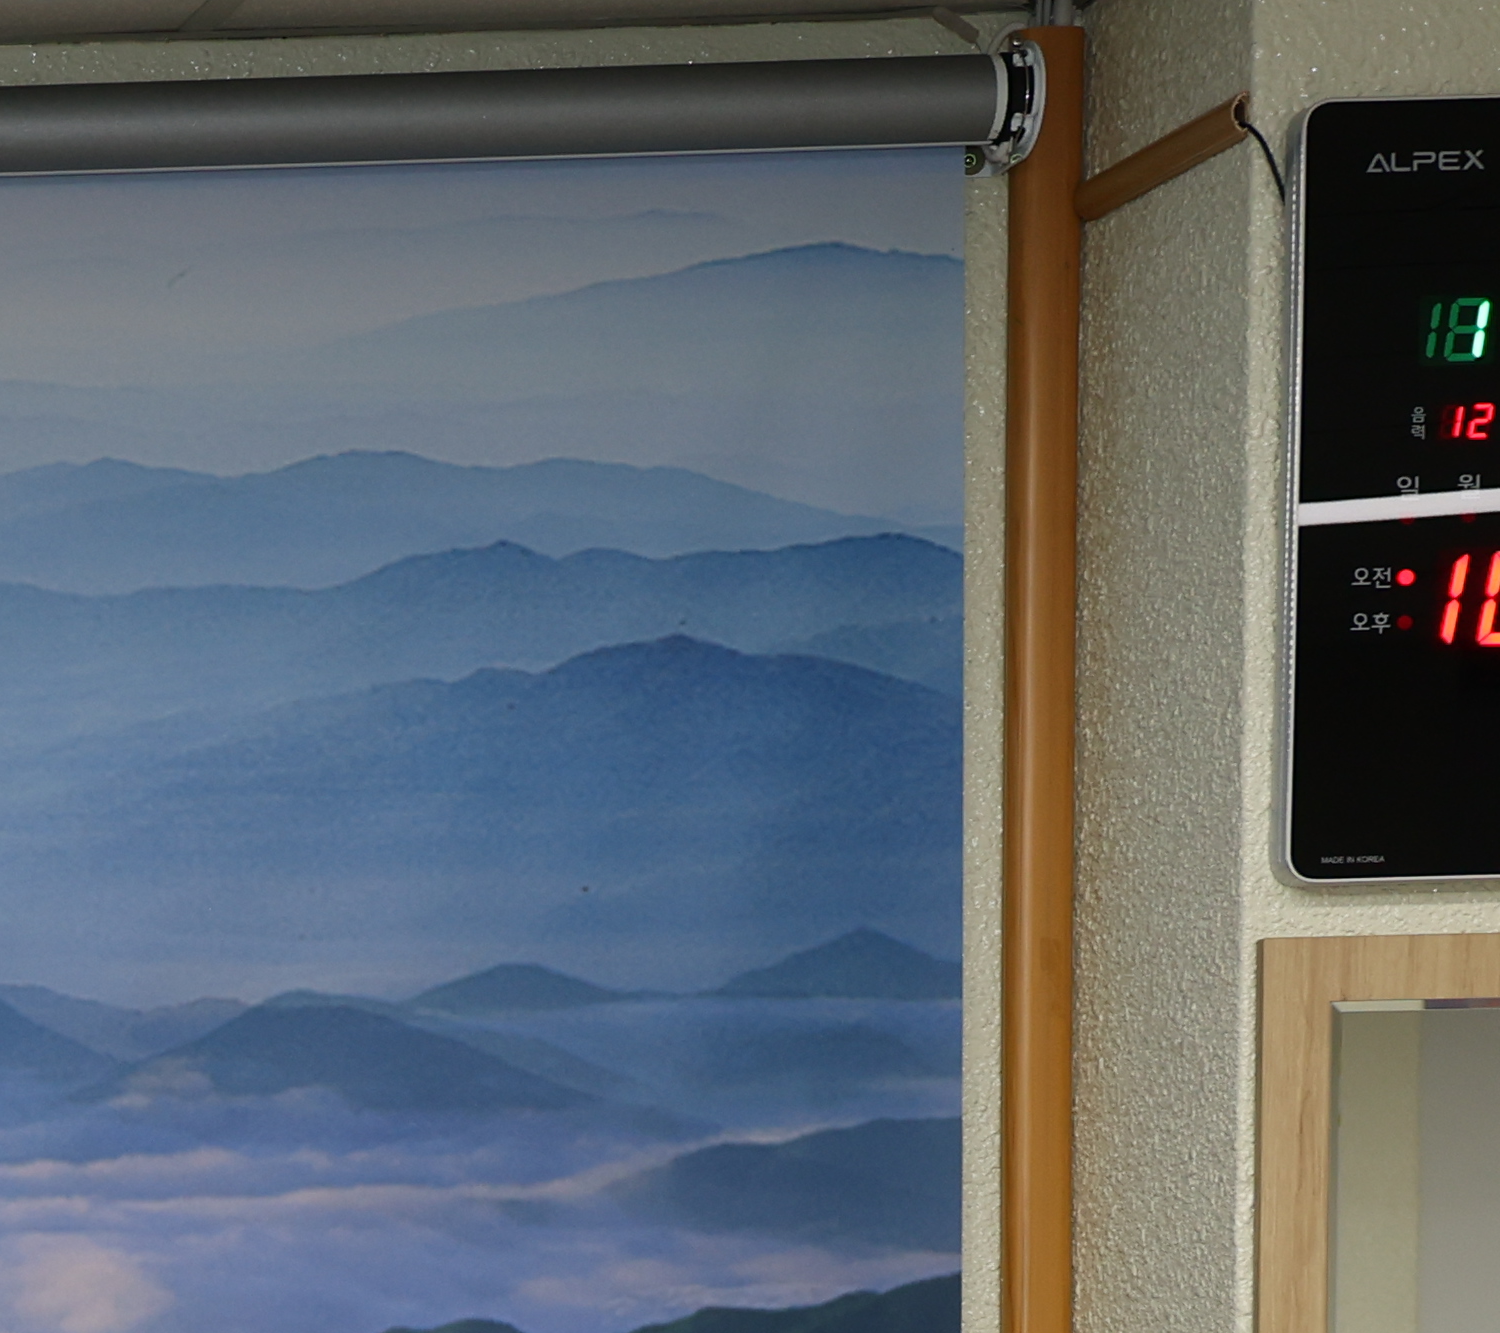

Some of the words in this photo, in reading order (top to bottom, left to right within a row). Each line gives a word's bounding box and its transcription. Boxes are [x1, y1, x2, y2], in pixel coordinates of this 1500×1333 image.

[1366, 150, 1485, 173] ALPEX
[1411, 406, 1426, 440] 음력
[1452, 403, 1495, 440] 12
[1351, 567, 1392, 589] 오전
[1350, 612, 1391, 634] 오후
[1346, 856, 1355, 864] IN
